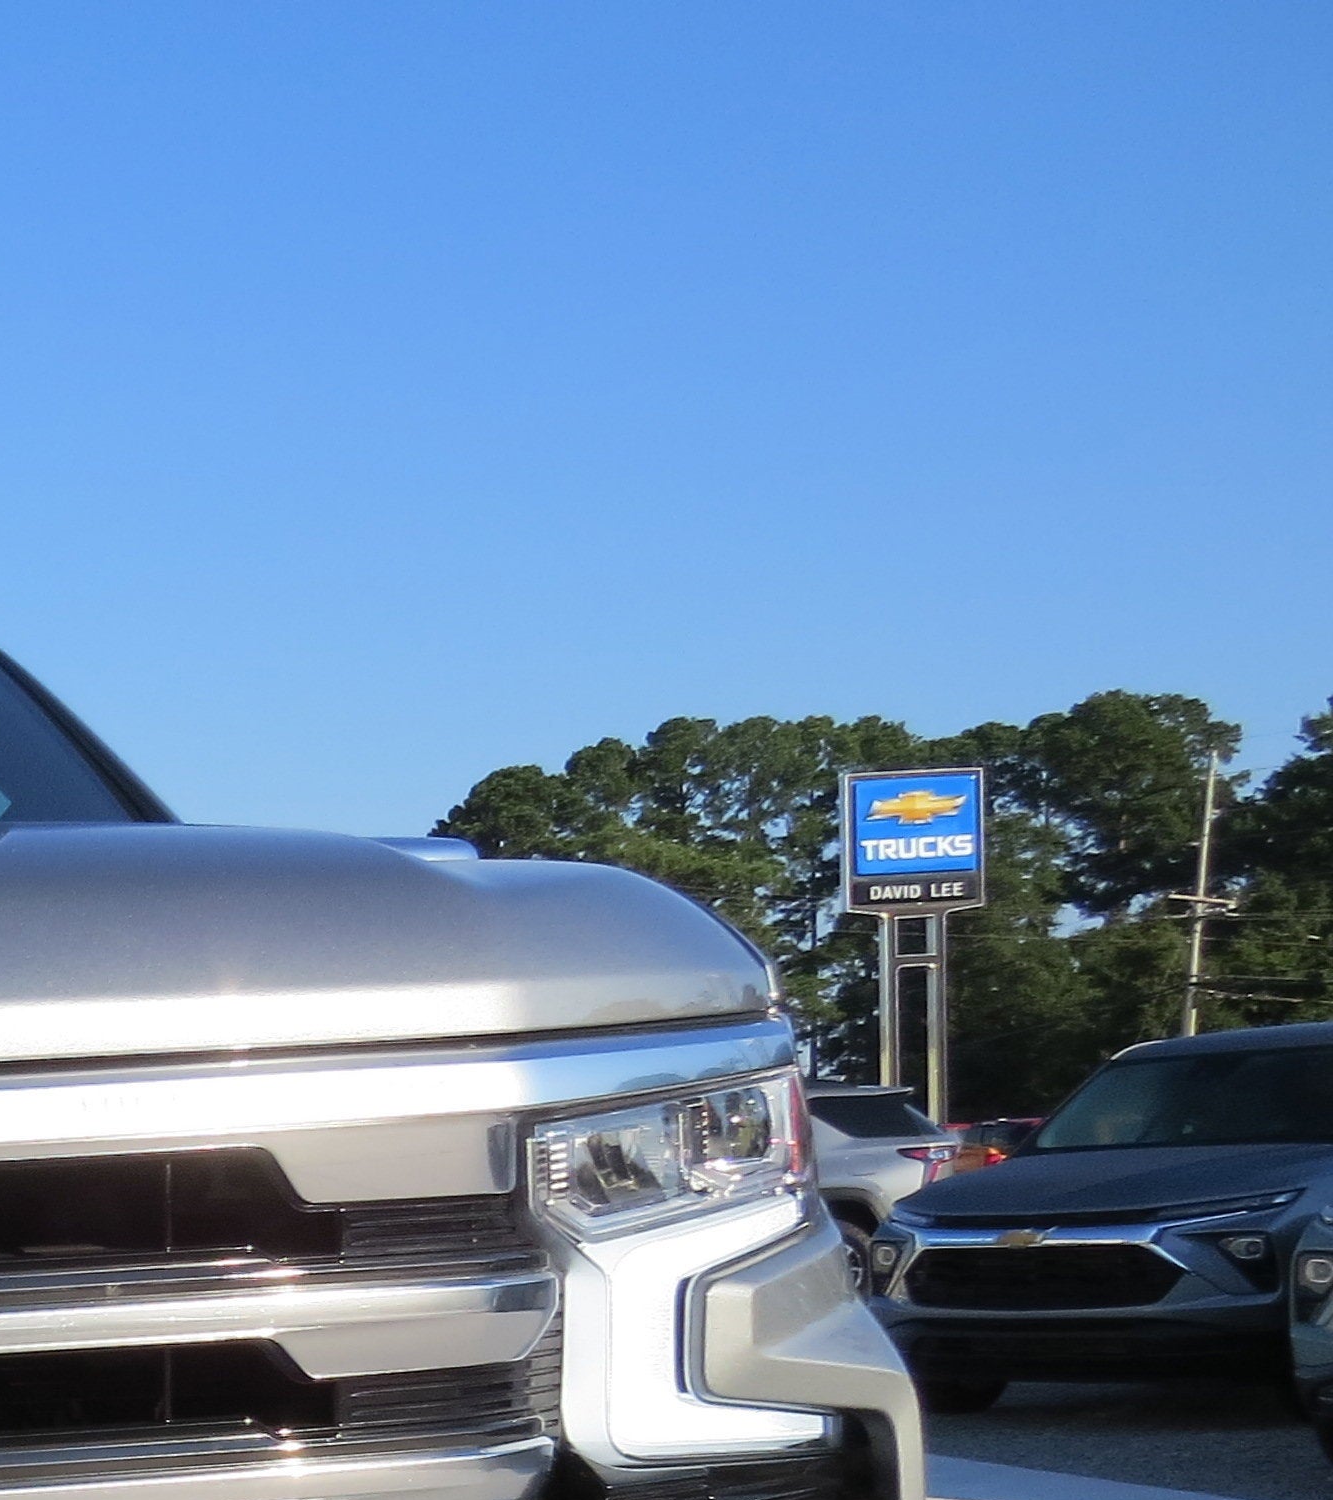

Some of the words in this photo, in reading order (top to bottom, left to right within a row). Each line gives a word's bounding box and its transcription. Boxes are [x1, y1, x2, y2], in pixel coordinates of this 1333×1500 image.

[860, 834, 974, 861] TRUCKS
[869, 885, 922, 901] DAVID
[930, 881, 965, 898] LEE
